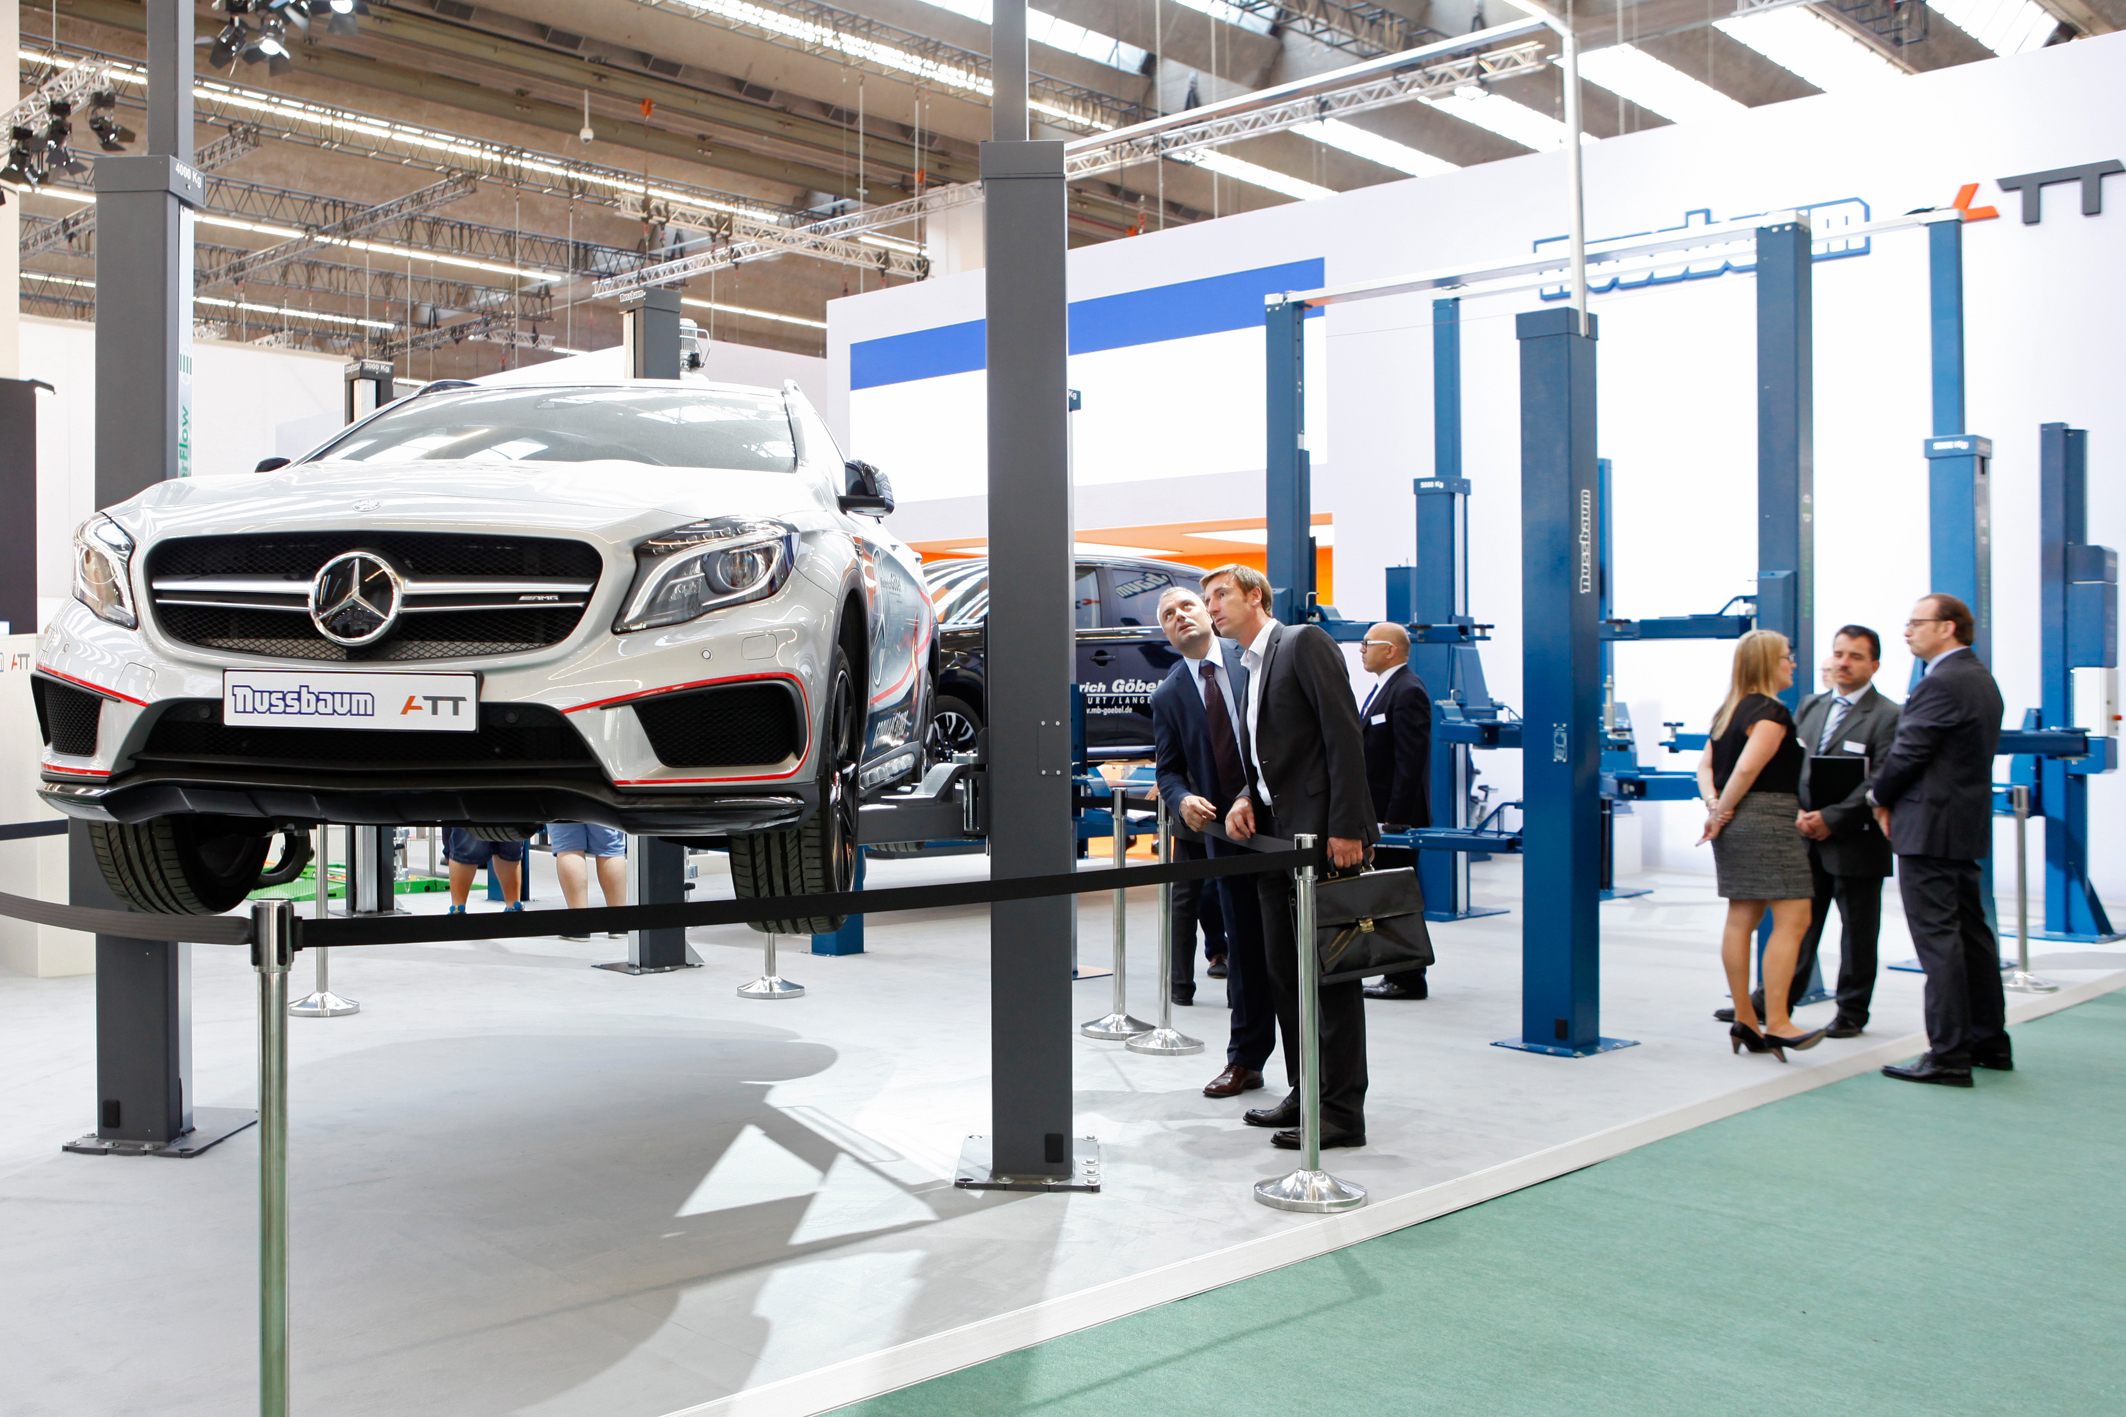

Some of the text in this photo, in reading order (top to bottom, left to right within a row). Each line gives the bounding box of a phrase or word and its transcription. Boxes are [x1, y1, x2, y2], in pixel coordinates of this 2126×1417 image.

[175, 162, 202, 189] 4000 Kg
[1579, 489, 1591, 593] Nussbaum
[11, 653, 30, 671] ATT
[232, 685, 467, 716] Nussbaum ATT
